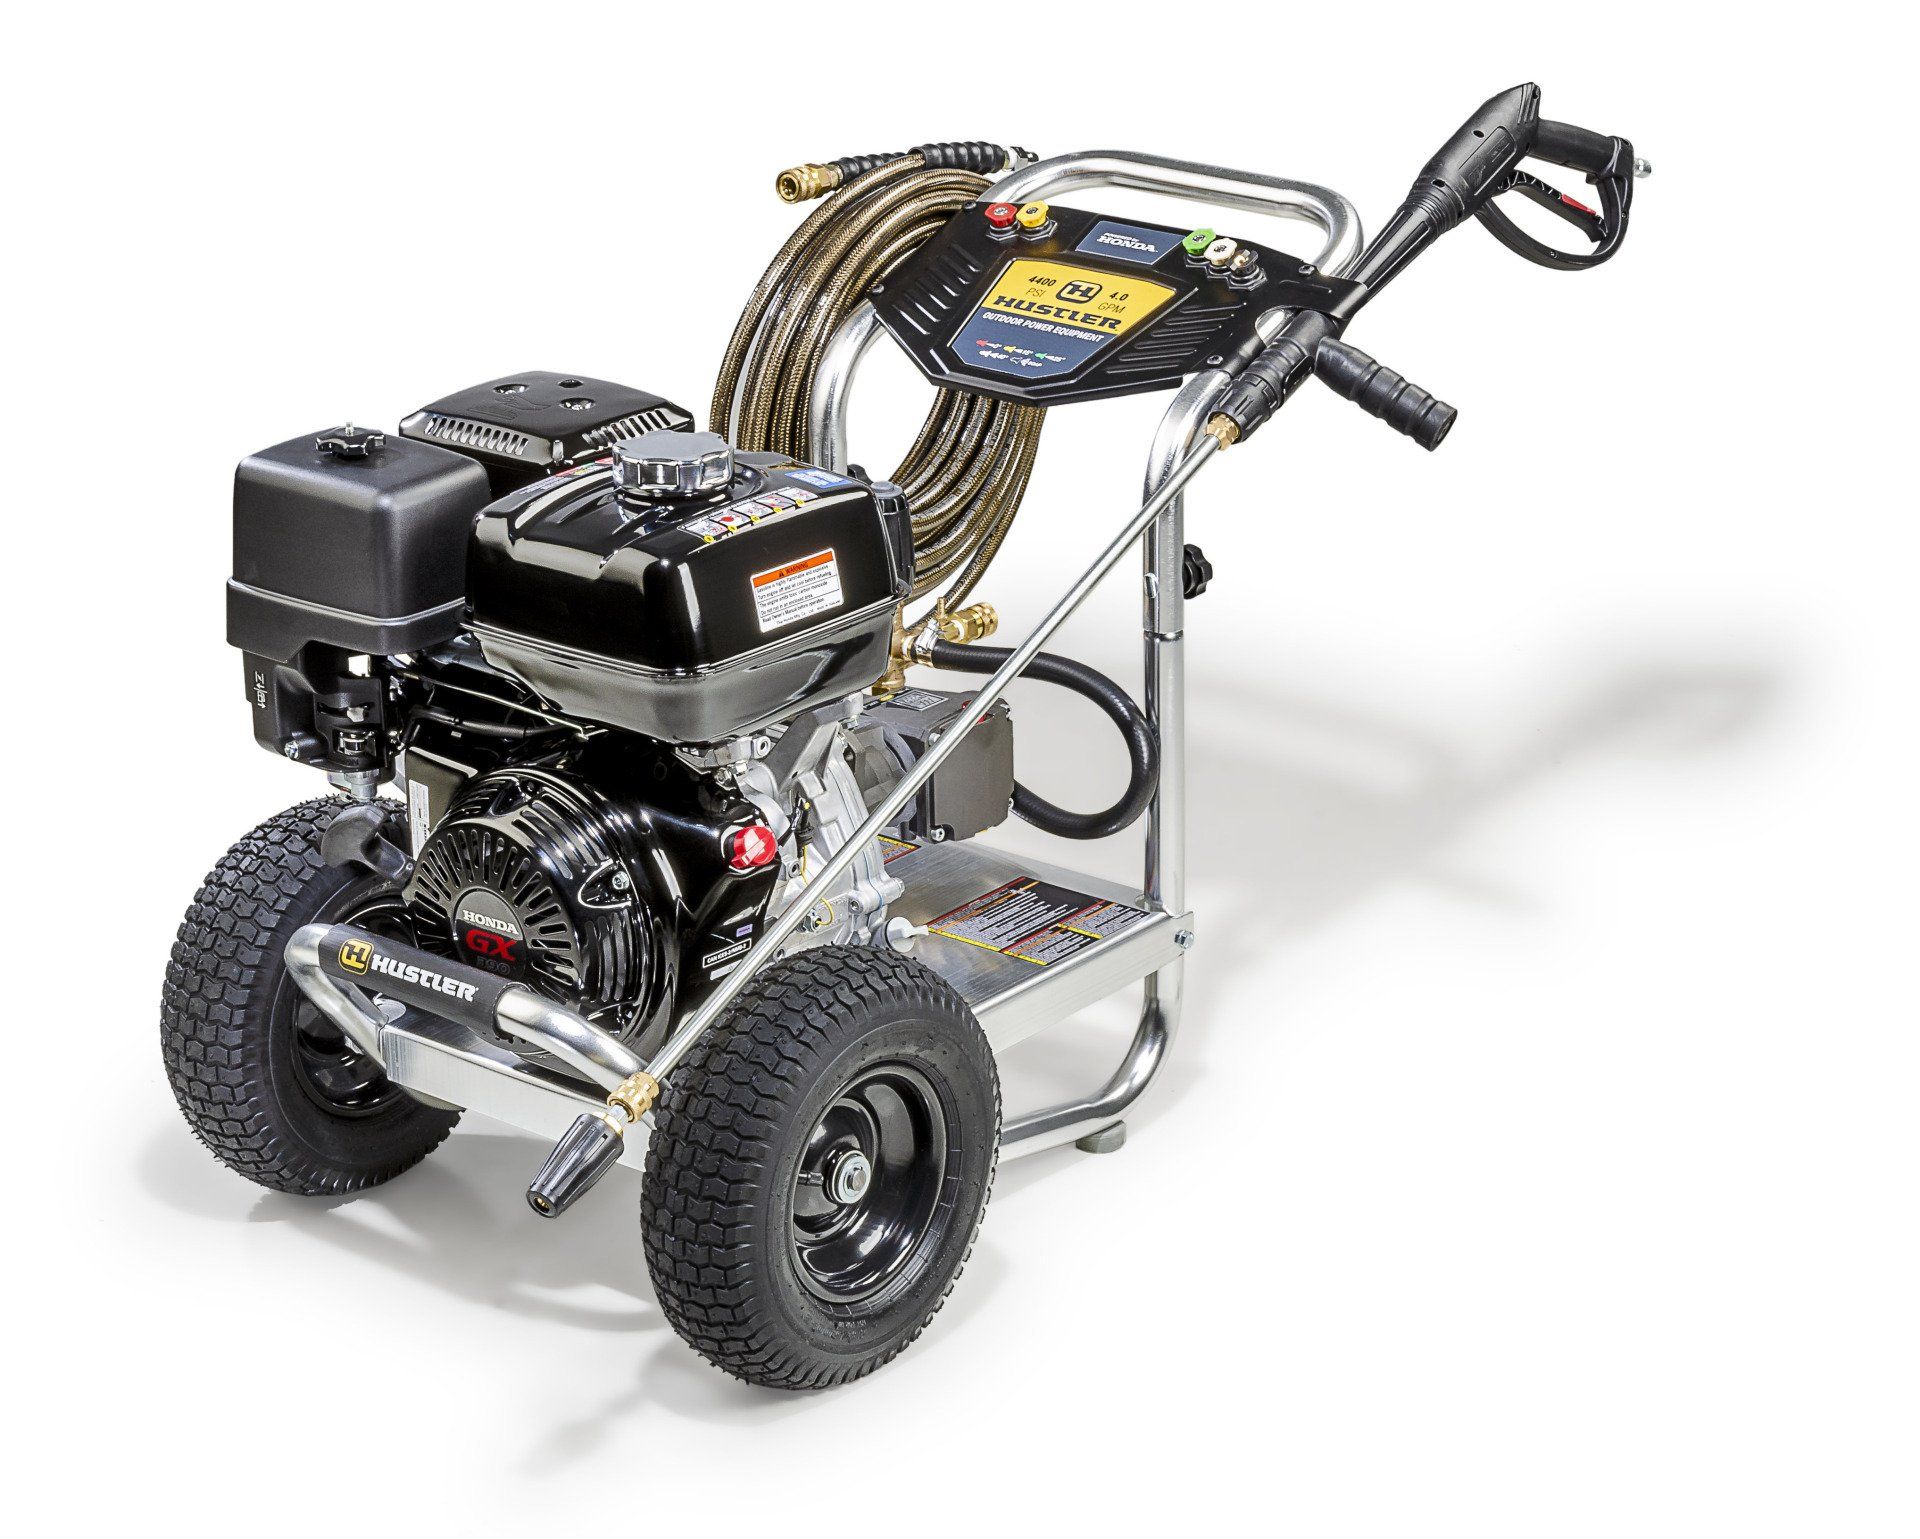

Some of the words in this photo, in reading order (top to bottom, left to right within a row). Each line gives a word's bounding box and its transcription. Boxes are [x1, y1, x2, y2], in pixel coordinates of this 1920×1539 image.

[1096, 235, 1156, 252] HONDA
[1028, 275, 1057, 287] 4400
[1025, 287, 1046, 298] PSI
[1109, 291, 1129, 301] 4.0
[993, 295, 1122, 330] HUSTLER
[1097, 301, 1126, 314] GPM
[982, 311, 1025, 327] OUTDOOR
[1021, 319, 1056, 333] POWER
[1052, 326, 1105, 343] EQUIPMENT
[462, 909, 519, 935] HONDA
[465, 928, 518, 962] GX
[370, 953, 478, 1003] HUSTLER
